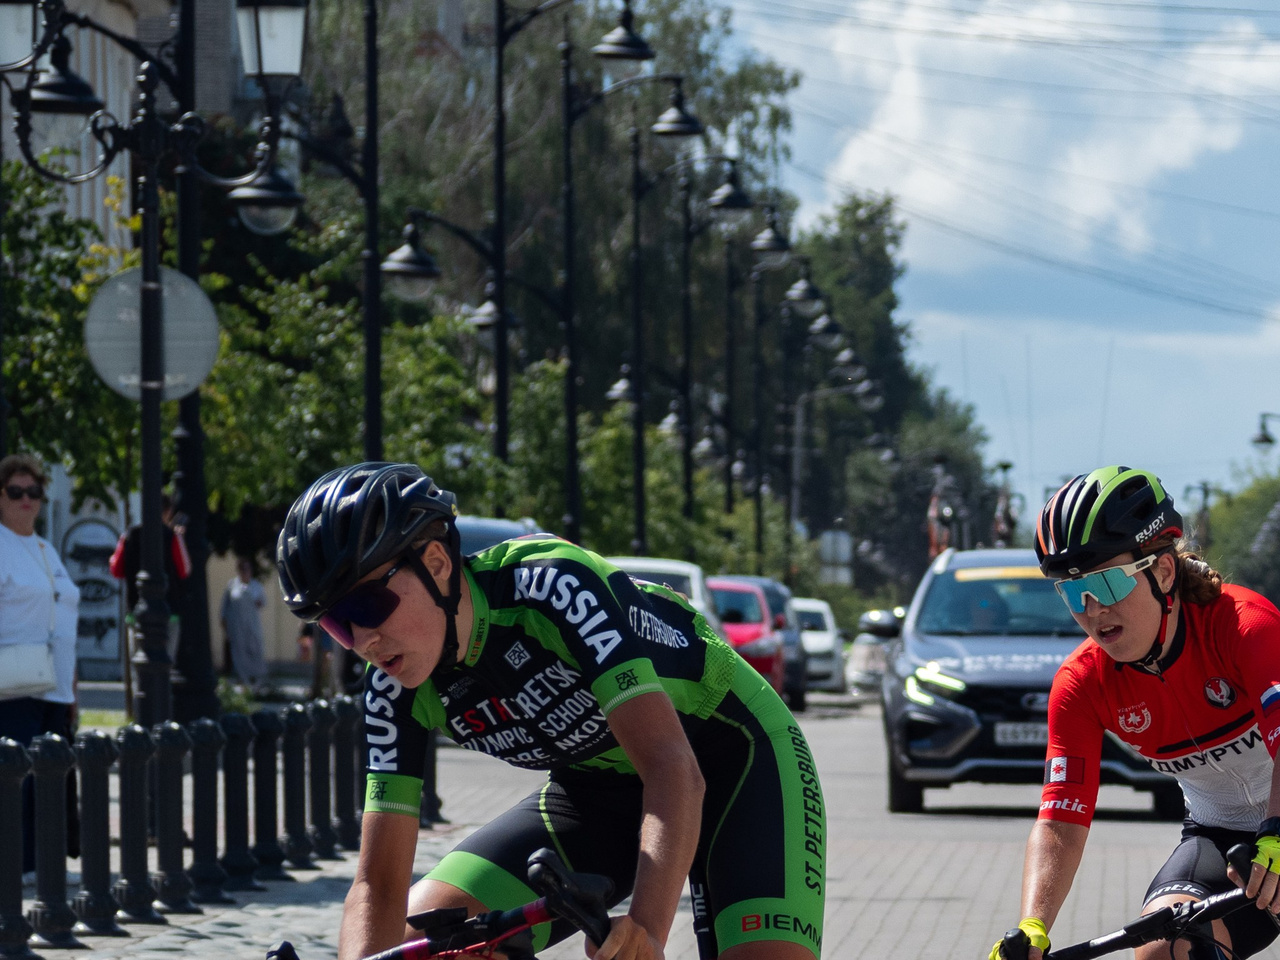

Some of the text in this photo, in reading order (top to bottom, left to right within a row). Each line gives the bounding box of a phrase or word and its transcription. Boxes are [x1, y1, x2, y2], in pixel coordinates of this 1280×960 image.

[1135, 512, 1164, 542] RUDY
[514, 566, 623, 665] RUSSIA
[615, 669, 635, 684] FAT
[618, 676, 639, 691] CAT
[365, 667, 402, 771] RUSS
[1148, 730, 1262, 774] ДМУРТИ
[369, 791, 387, 801] CAT
[371, 782, 388, 791] FAT
[1039, 798, 1088, 814] antic
[1143, 884, 1204, 908] antic
[742, 913, 822, 950] BIEMM
